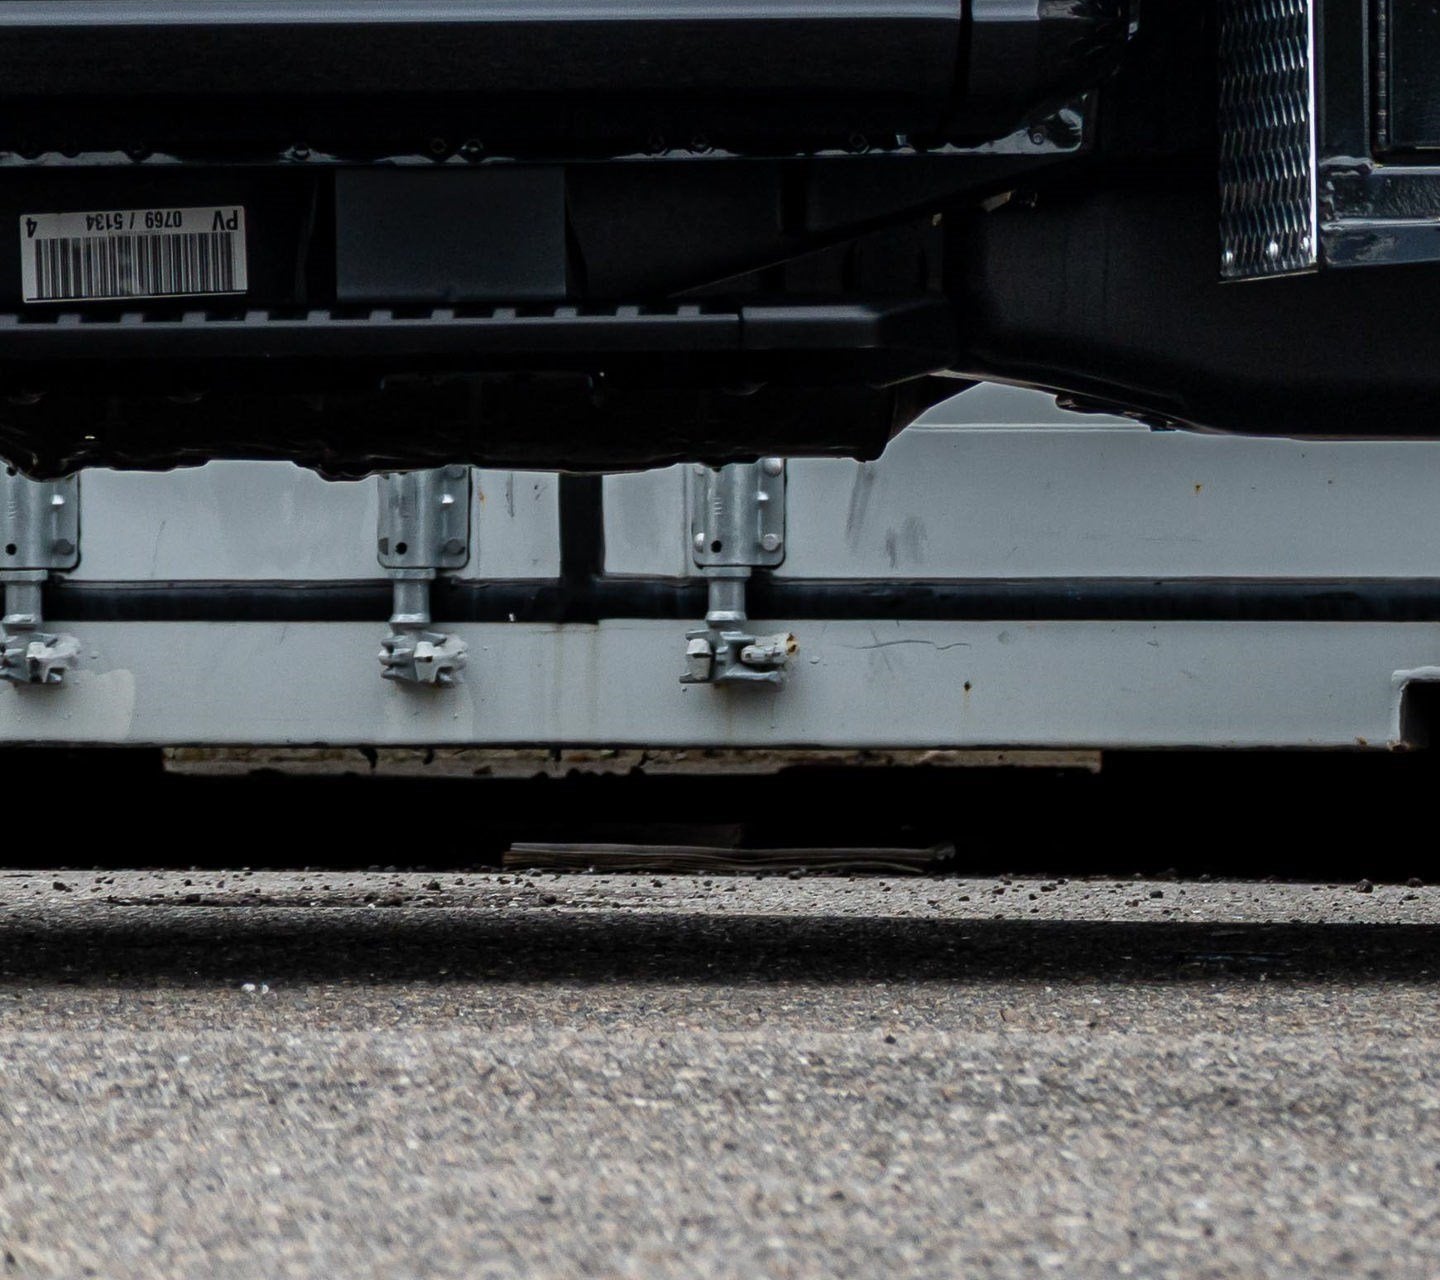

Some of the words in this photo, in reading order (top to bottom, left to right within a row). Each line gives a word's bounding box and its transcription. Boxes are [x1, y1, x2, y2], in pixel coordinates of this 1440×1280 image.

[26, 217, 38, 238] 4
[86, 214, 124, 231] 5134
[145, 211, 182, 228] 0769
[213, 210, 239, 231] PV
